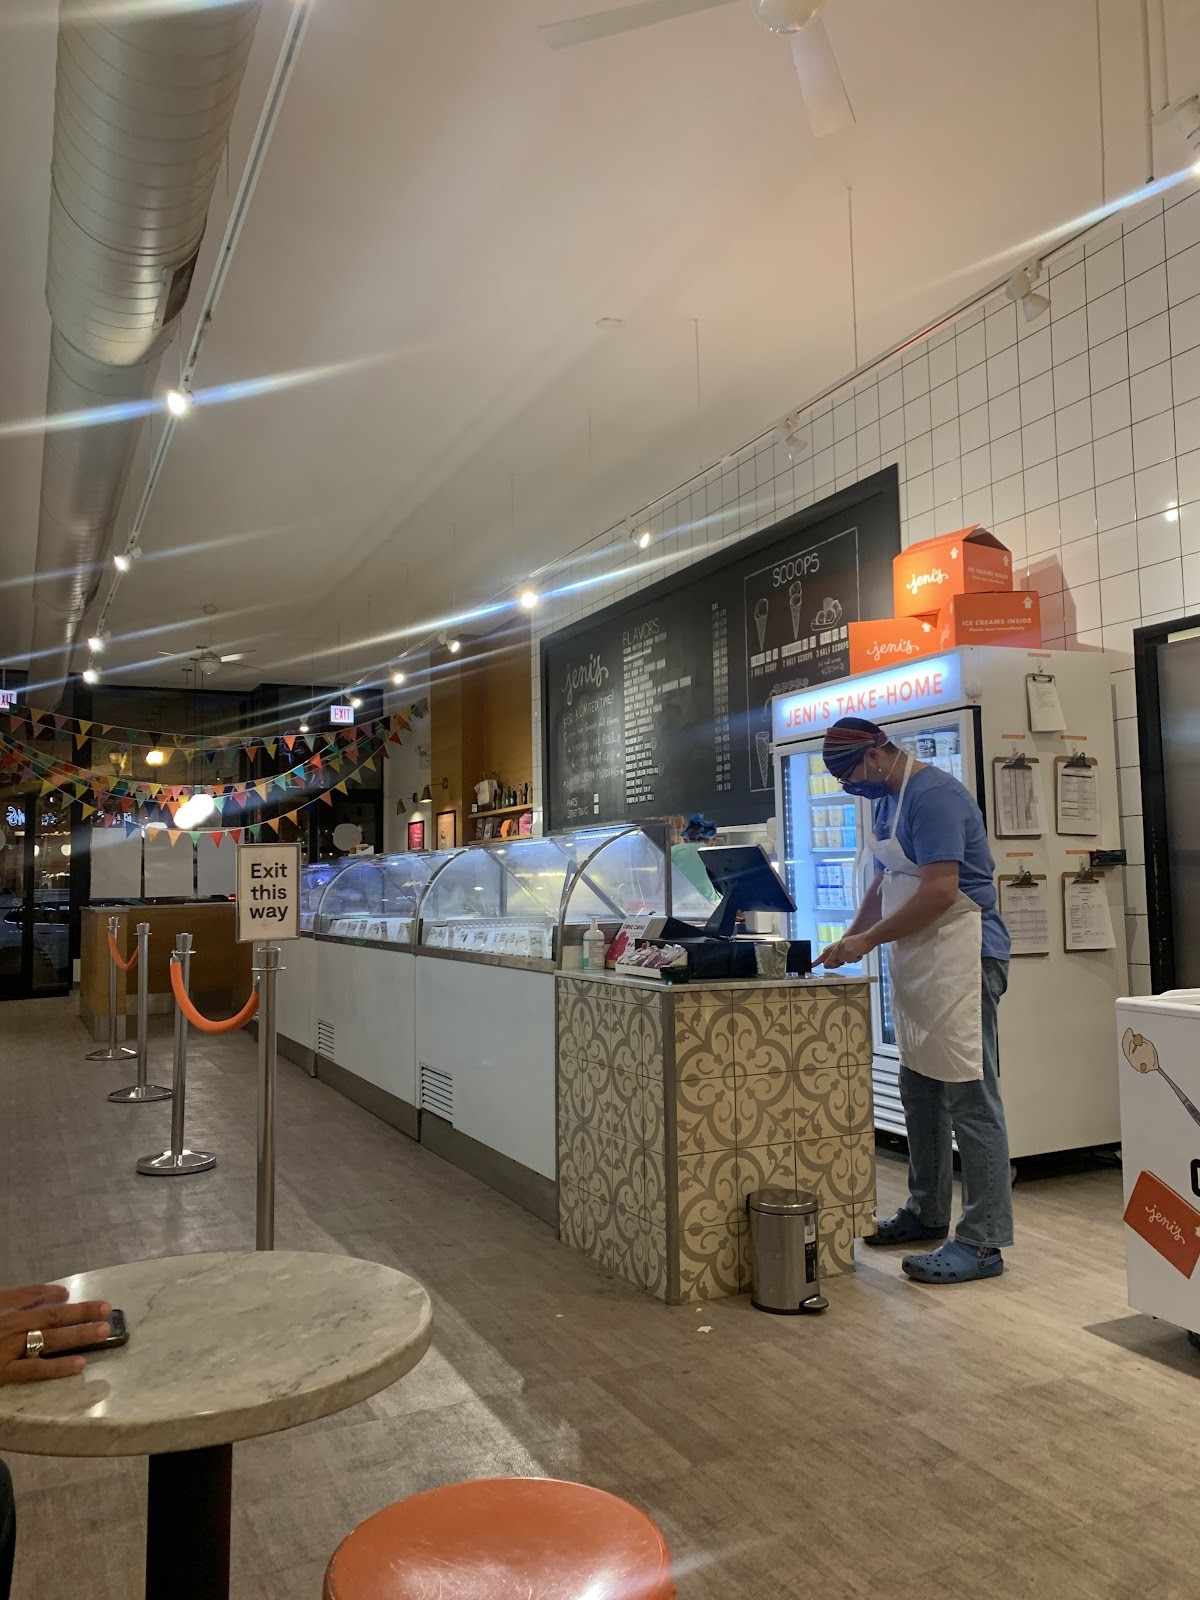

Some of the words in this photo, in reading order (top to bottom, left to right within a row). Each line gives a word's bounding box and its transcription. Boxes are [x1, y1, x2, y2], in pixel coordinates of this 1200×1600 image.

[772, 552, 820, 588] SCOOPS
[905, 567, 949, 594] jeni's
[622, 617, 660, 647] FLAVORS
[975, 618, 1005, 626] CREAMS
[1006, 617, 1032, 625] INSIDE
[831, 640, 849, 653] SCOOPS
[866, 638, 919, 661] jeni's
[561, 653, 609, 706] jeni's
[785, 700, 830, 728] JENI'S
[836, 672, 944, 718] TAKE-HOME
[334, 707, 351, 721] EXIT
[251, 862, 288, 879] Exit
[250, 884, 287, 900] this
[249, 905, 289, 922] way
[1145, 1204, 1186, 1245] jeni's
